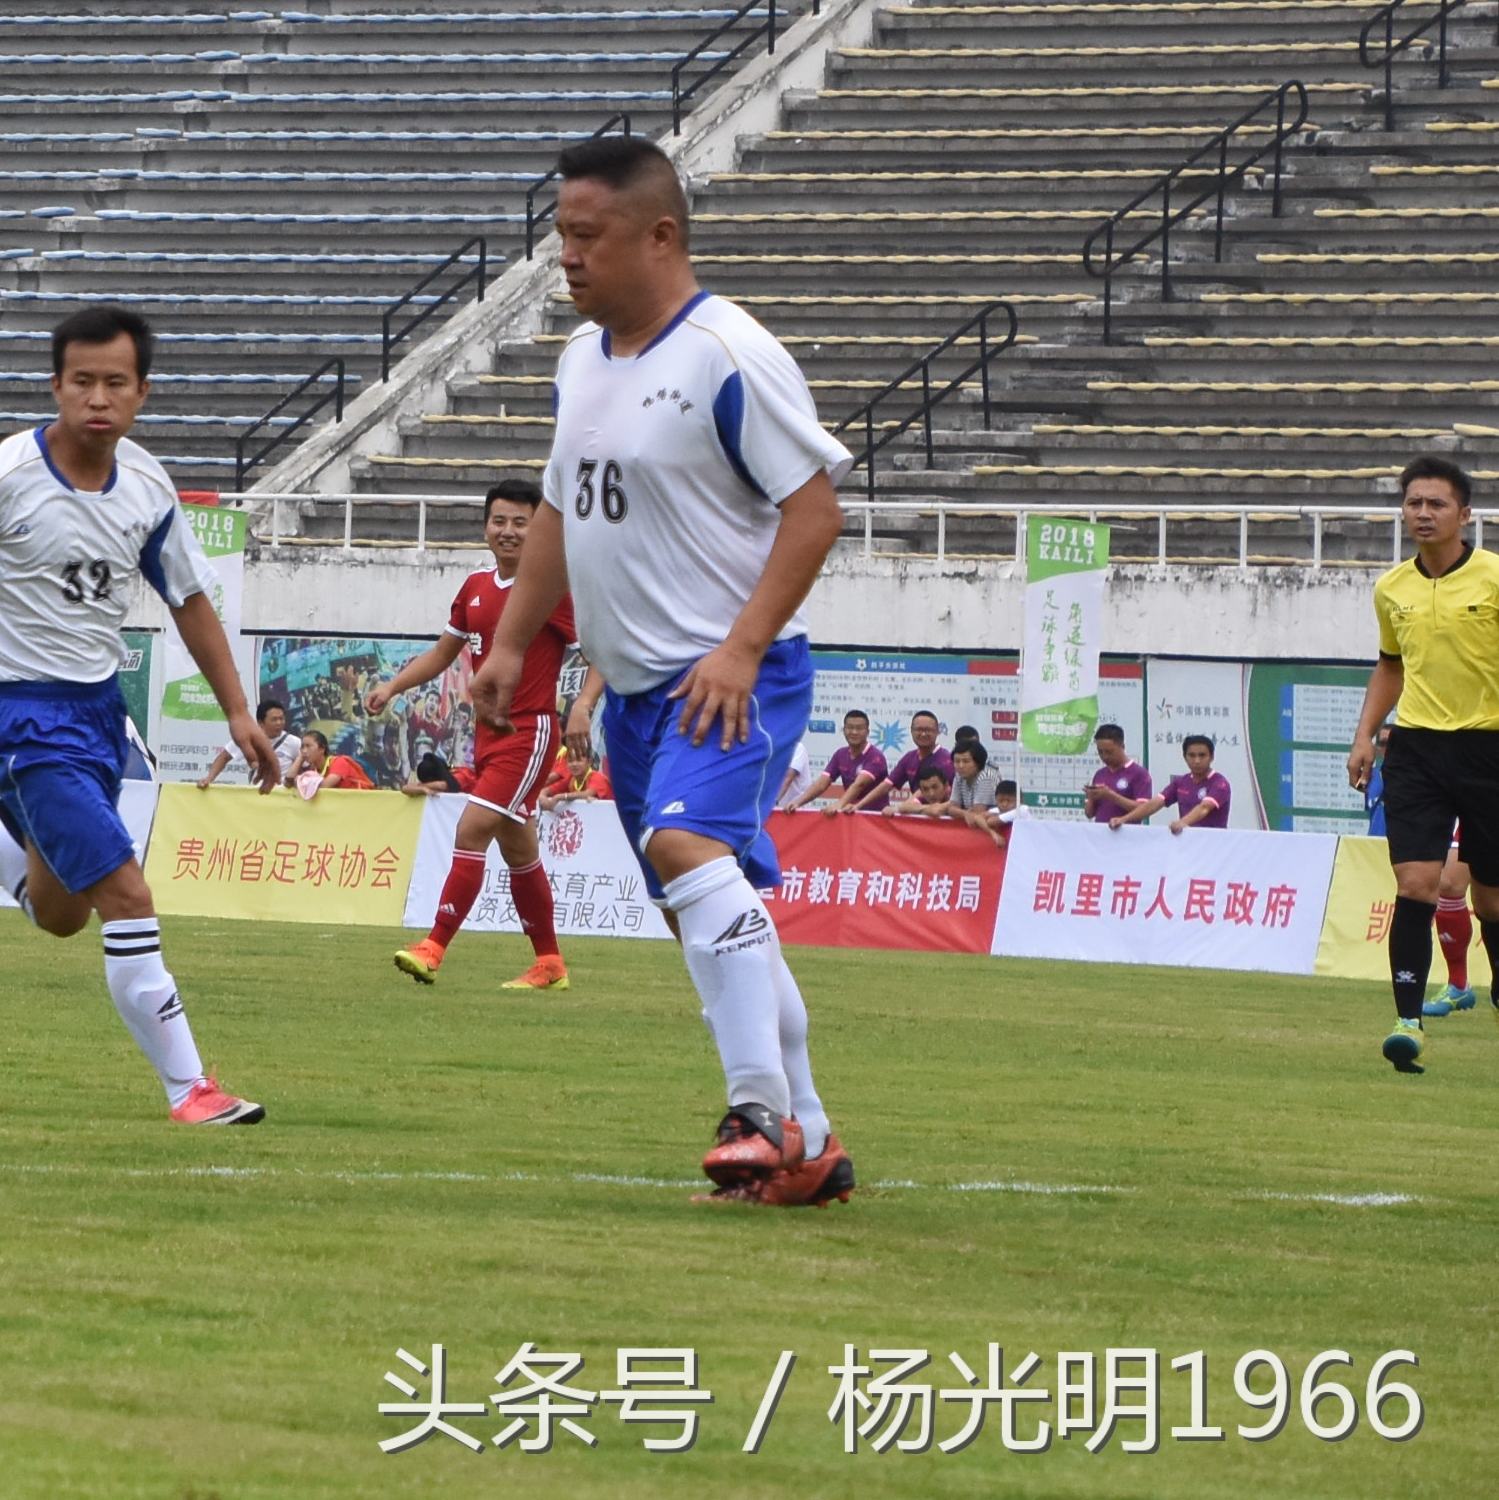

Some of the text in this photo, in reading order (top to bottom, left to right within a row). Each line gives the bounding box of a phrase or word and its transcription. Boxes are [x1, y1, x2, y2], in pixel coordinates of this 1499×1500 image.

[574, 458, 628, 524] 36
[186, 510, 234, 533] 2018
[1040, 524, 1095, 548] 2018
[199, 533, 233, 549] AILI
[1039, 544, 1093, 564] KAILI
[60, 558, 111, 604] 32
[1041, 590, 1059, 684] 足球争霸
[1176, 705, 1230, 716] 中国体育彩票
[172, 838, 400, 889] 贵州省足球协会
[468, 896, 645, 932] 资发有限公司
[1033, 870, 1299, 929] 凯里市人民政府
[714, 932, 771, 957] KEMPUT
